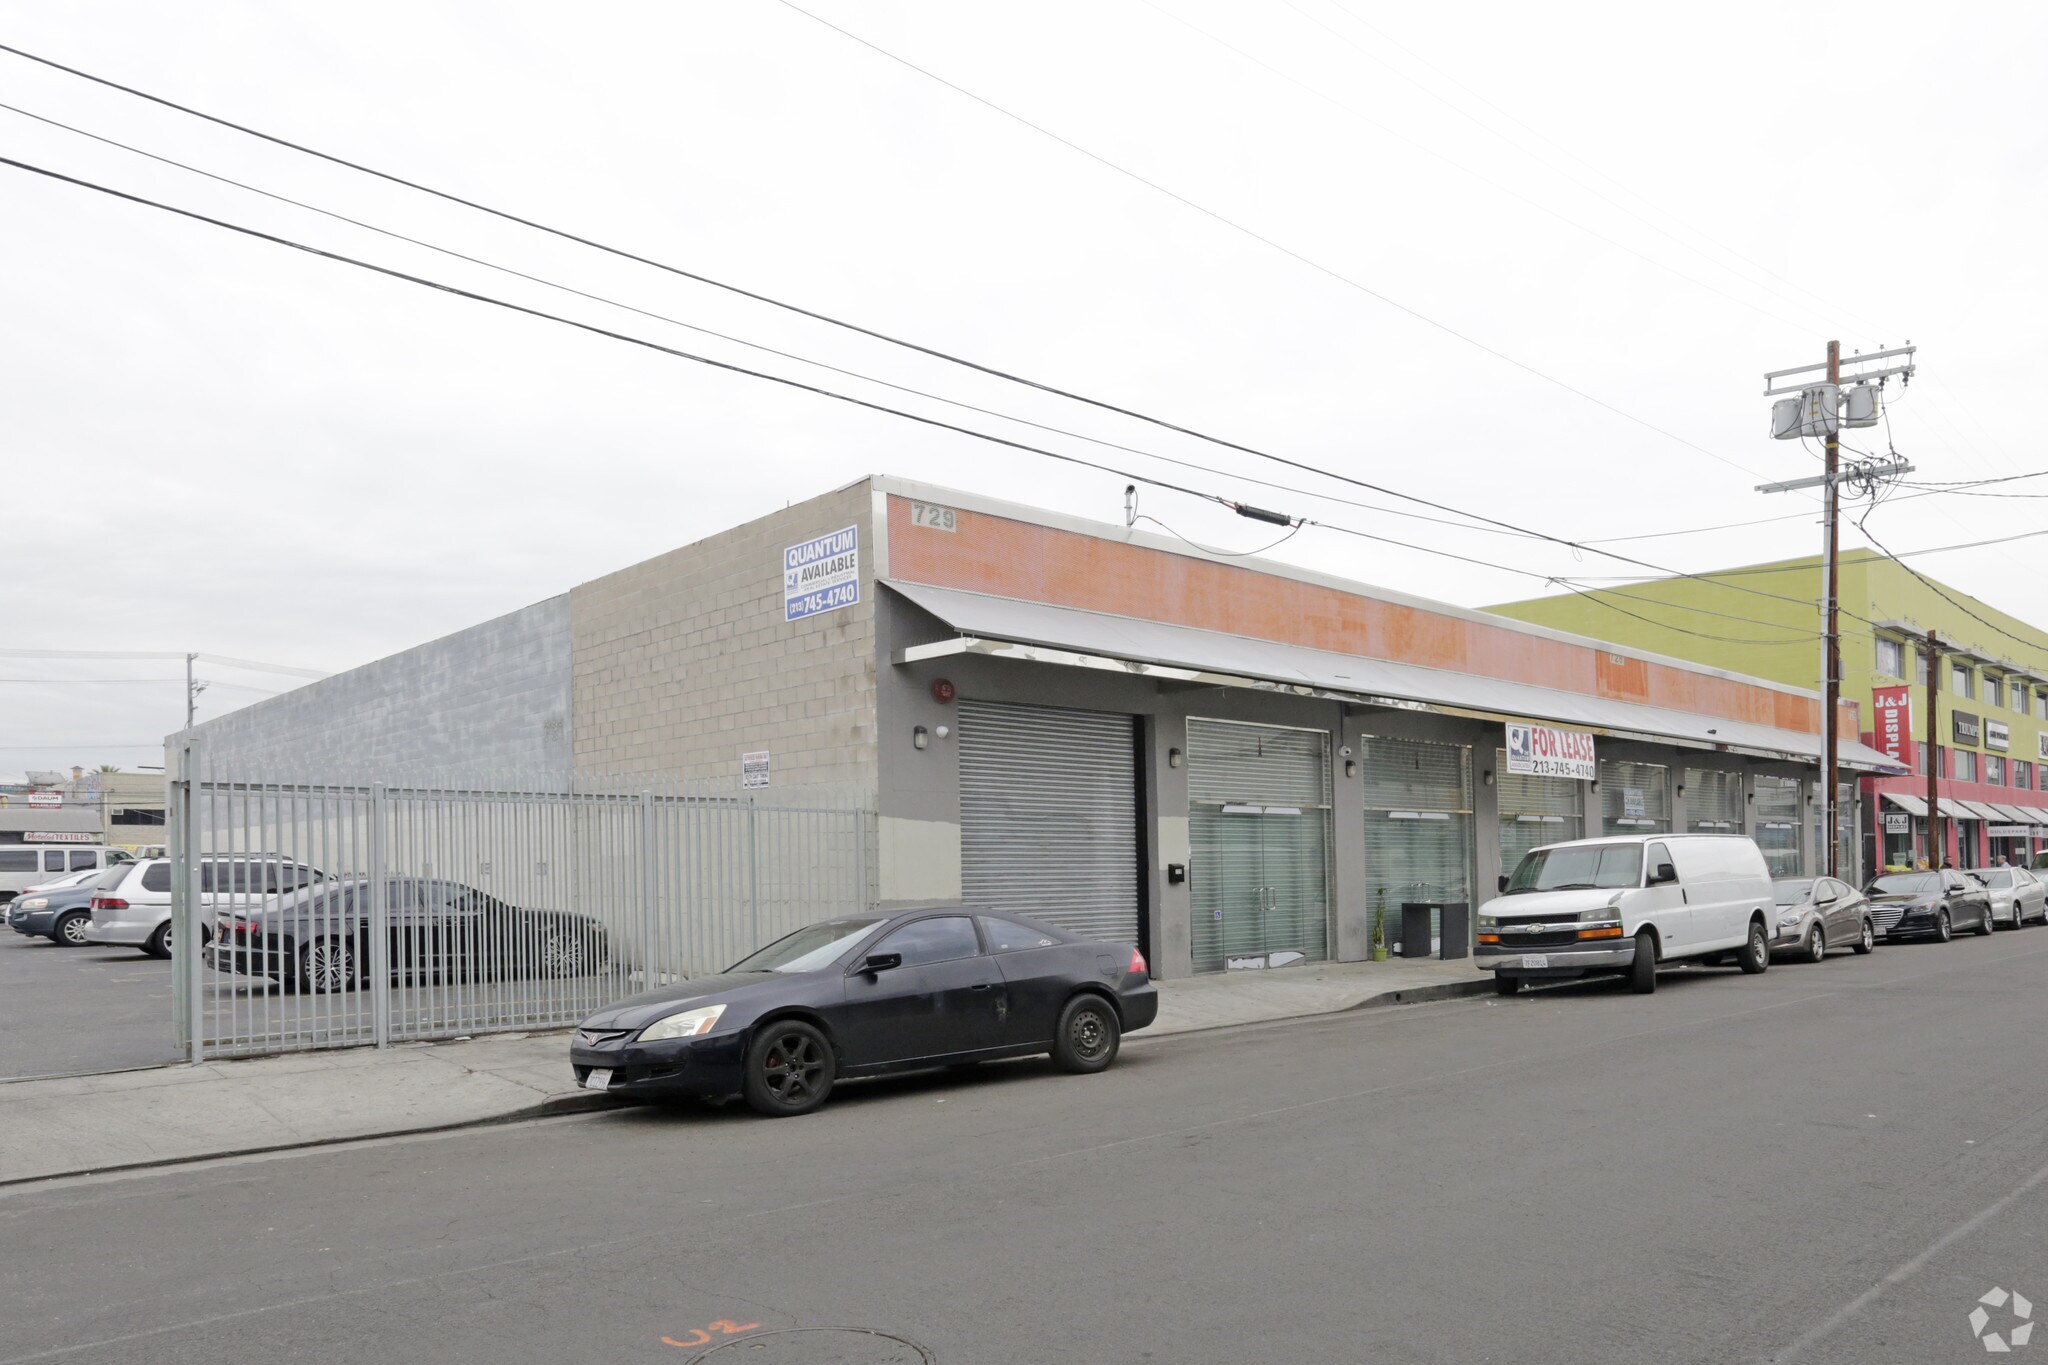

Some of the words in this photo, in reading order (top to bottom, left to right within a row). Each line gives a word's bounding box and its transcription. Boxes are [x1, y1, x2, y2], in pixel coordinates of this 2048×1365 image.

[914, 503, 954, 529] 729
[789, 530, 853, 567] QUANTUM
[801, 553, 855, 582] AVAILABLE
[789, 601, 804, 614] (213)
[804, 584, 855, 613] 745-4740
[1531, 727, 1558, 757] FOR
[1560, 732, 1593, 761] LEASE
[1884, 709, 1900, 760] DISPLA
[1532, 760, 1594, 778] 213-745-4740
[54, 833, 90, 841] TEXTILES
